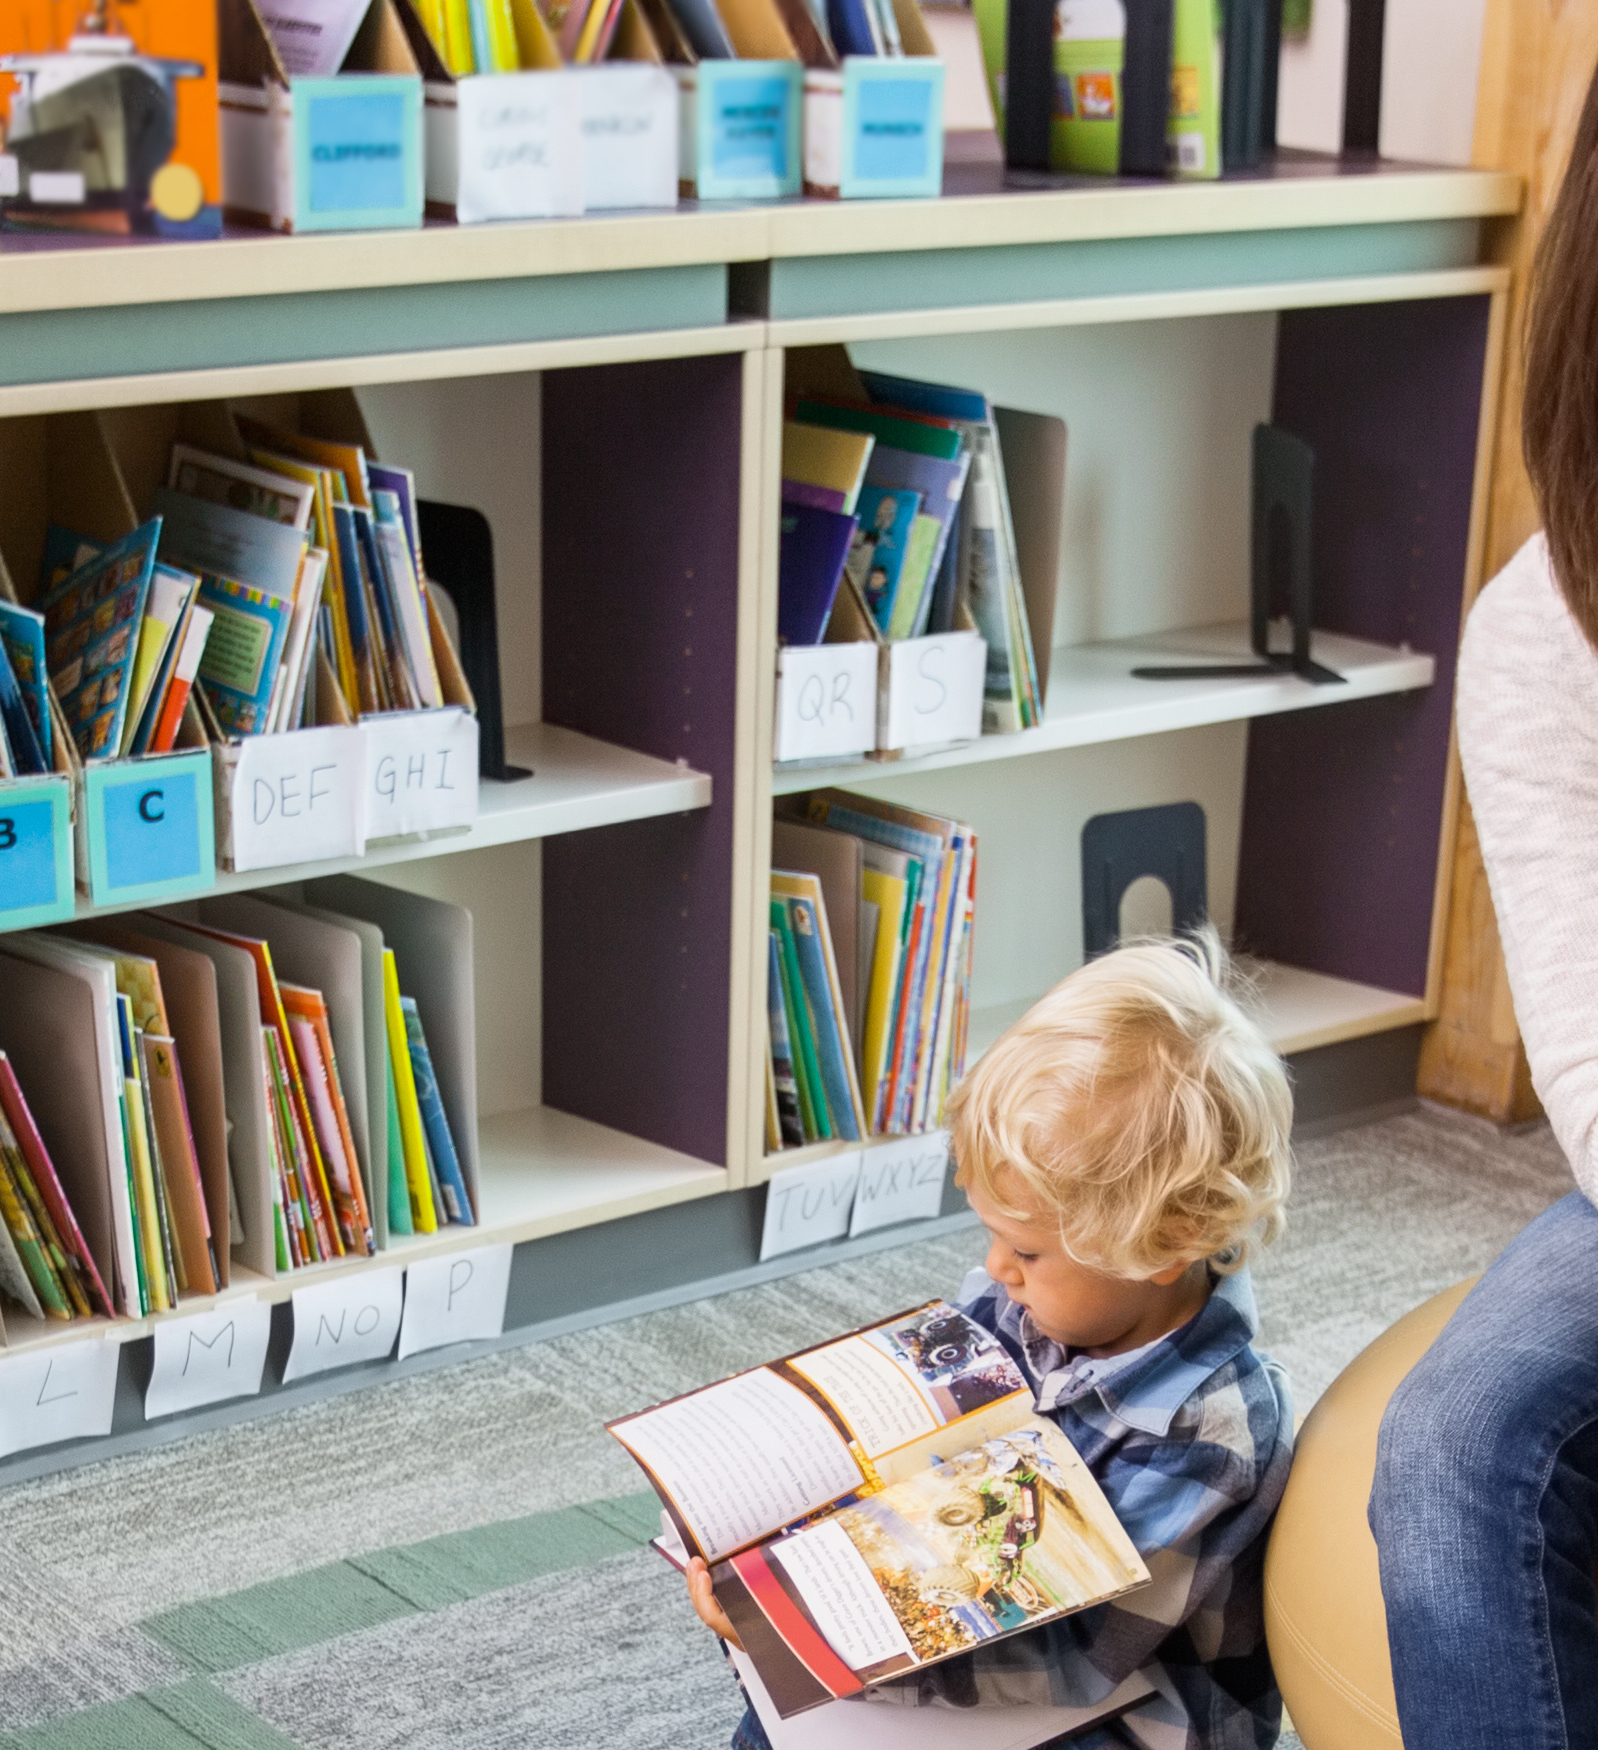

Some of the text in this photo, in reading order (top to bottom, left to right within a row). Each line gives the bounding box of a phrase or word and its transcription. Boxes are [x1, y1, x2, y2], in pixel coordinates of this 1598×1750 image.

[798, 671, 855, 726] QR
[914, 646, 947, 715] S
[138, 790, 166, 823] C
[775, 1172, 854, 1232] TUV
[447, 1259, 474, 1312] P
[182, 1320, 236, 1377] M
[315, 1304, 381, 1346] NO
[36, 1359, 79, 1406] L
[856, 1415, 882, 1448] TRICK
[778, 1455, 811, 1506] Getting Licensed
[700, 1525, 718, 1555] Breaking
